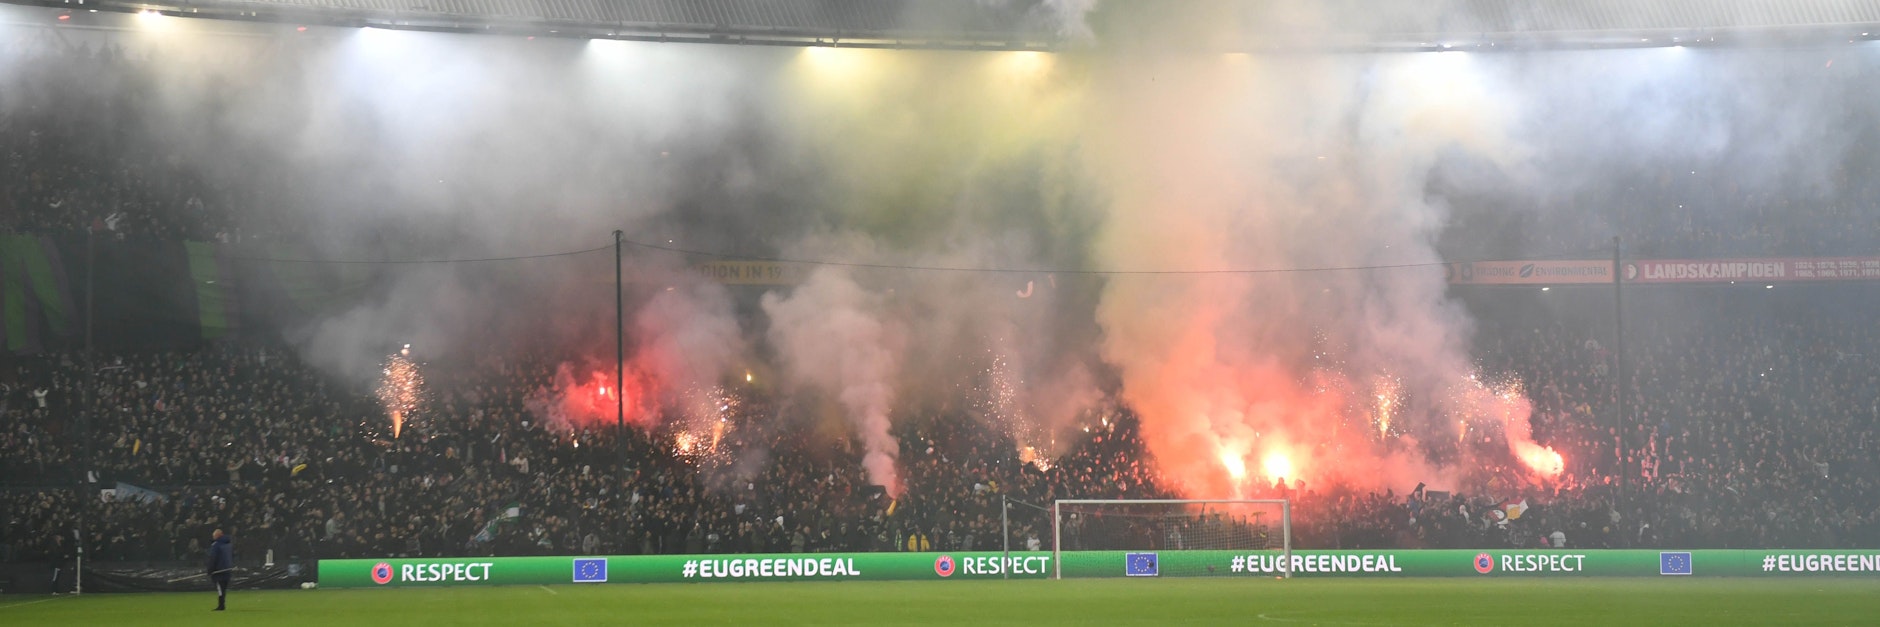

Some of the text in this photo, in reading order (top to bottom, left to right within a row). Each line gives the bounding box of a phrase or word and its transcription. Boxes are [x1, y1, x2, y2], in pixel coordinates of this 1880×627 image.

[746, 264, 762, 279] IN
[1644, 262, 1785, 279] LANDSKAMPIOEN
[682, 558, 860, 578] #EUGREENDEAL
[963, 556, 1050, 574] RESPECT
[1231, 554, 1402, 572] #EUGREENDEAL
[1501, 553, 1586, 572] RESPECT
[401, 562, 493, 583] RESPECT
